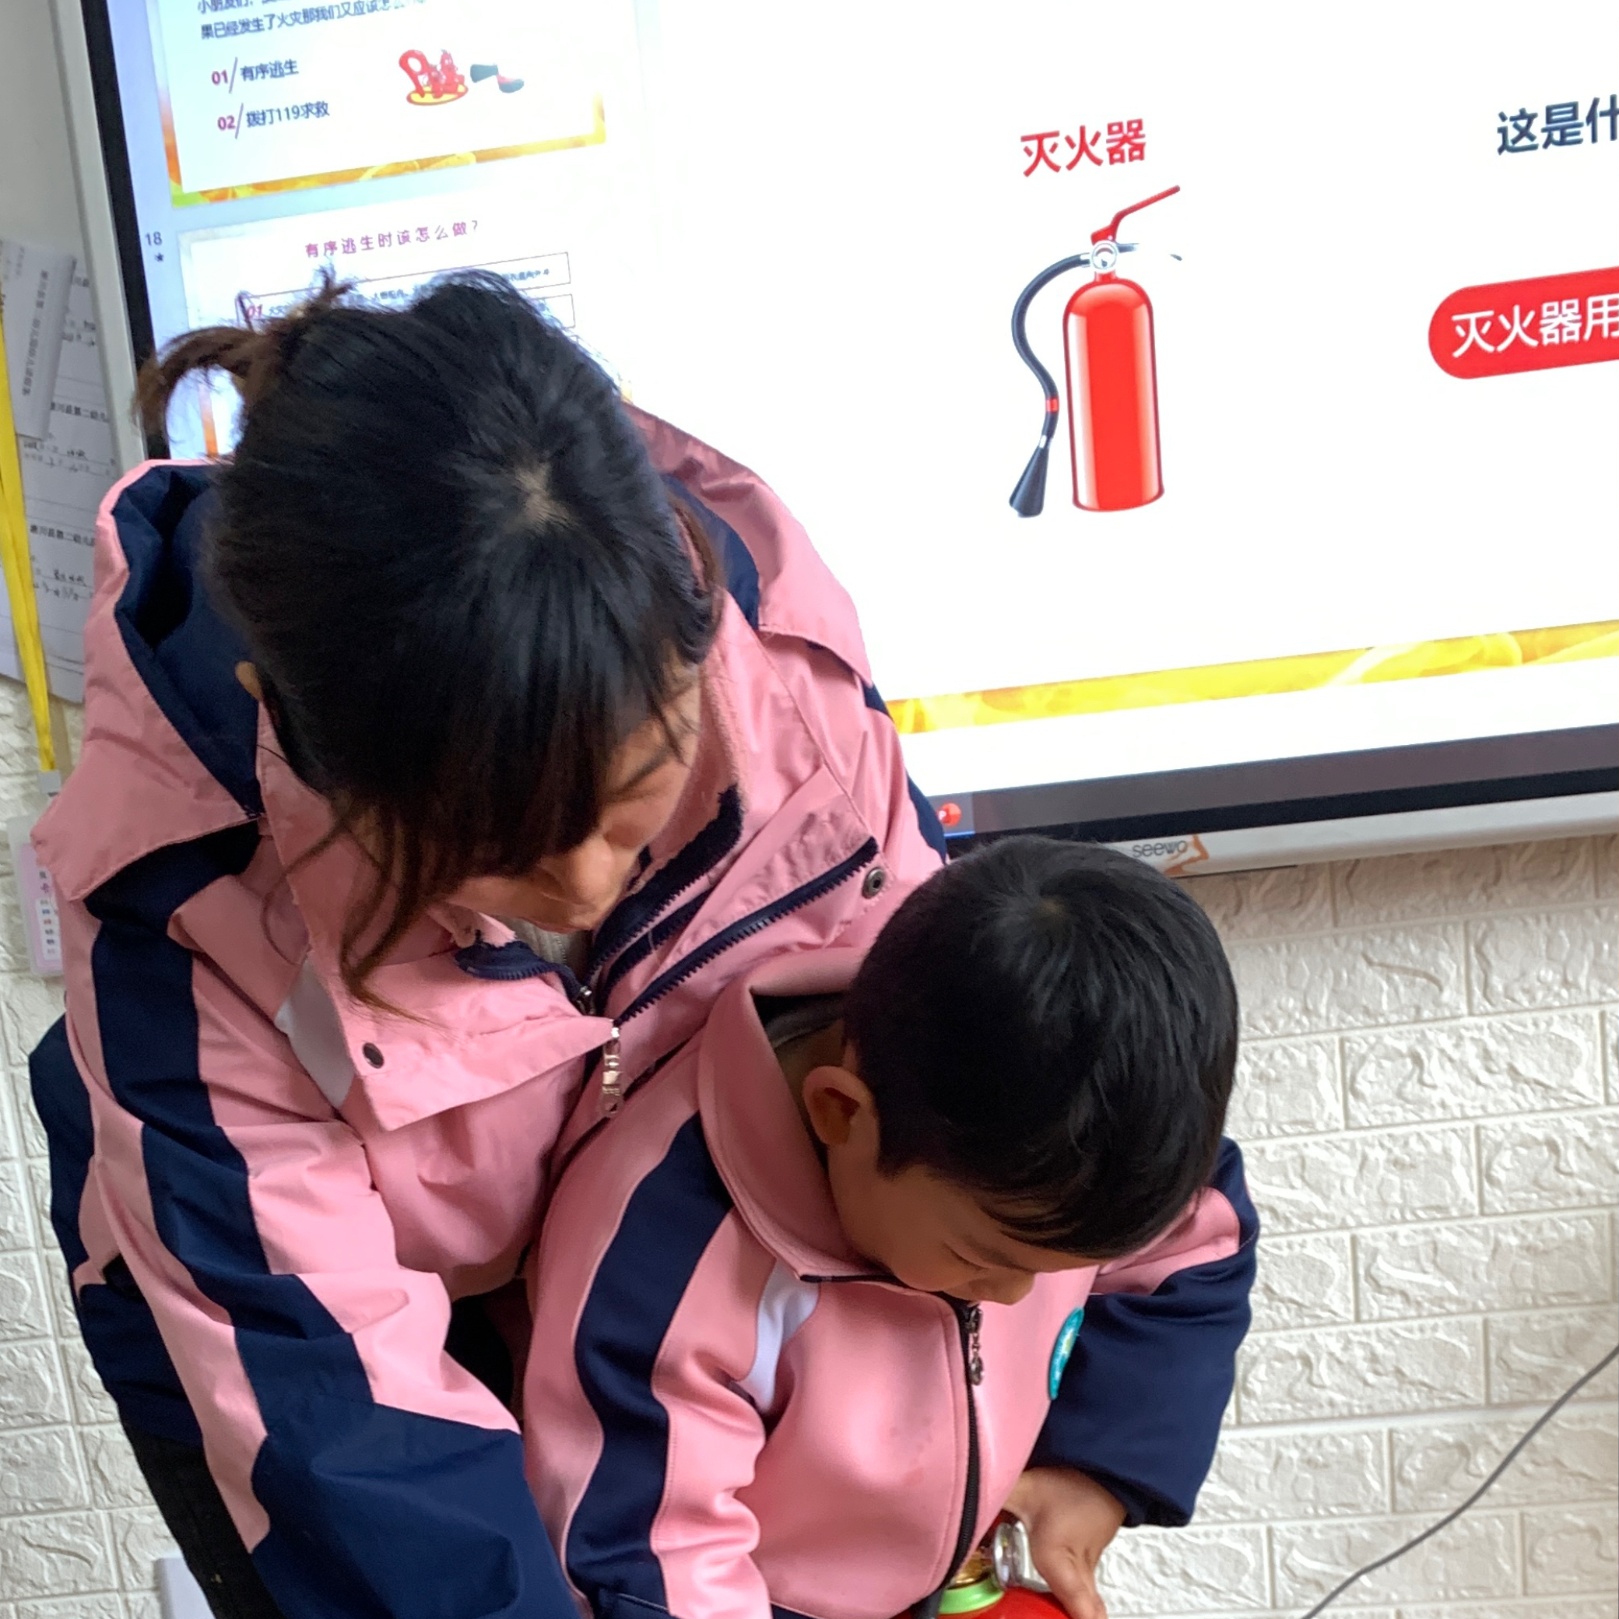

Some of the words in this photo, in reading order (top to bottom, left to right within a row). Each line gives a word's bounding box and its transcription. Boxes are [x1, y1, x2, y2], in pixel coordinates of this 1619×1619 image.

[240, 59, 299, 82] 有序逃生
[246, 100, 330, 128] 拨打119求救
[1020, 118, 1146, 177] 灭火器
[145, 231, 163, 246] 18
[1132, 840, 1188, 858] seewo
